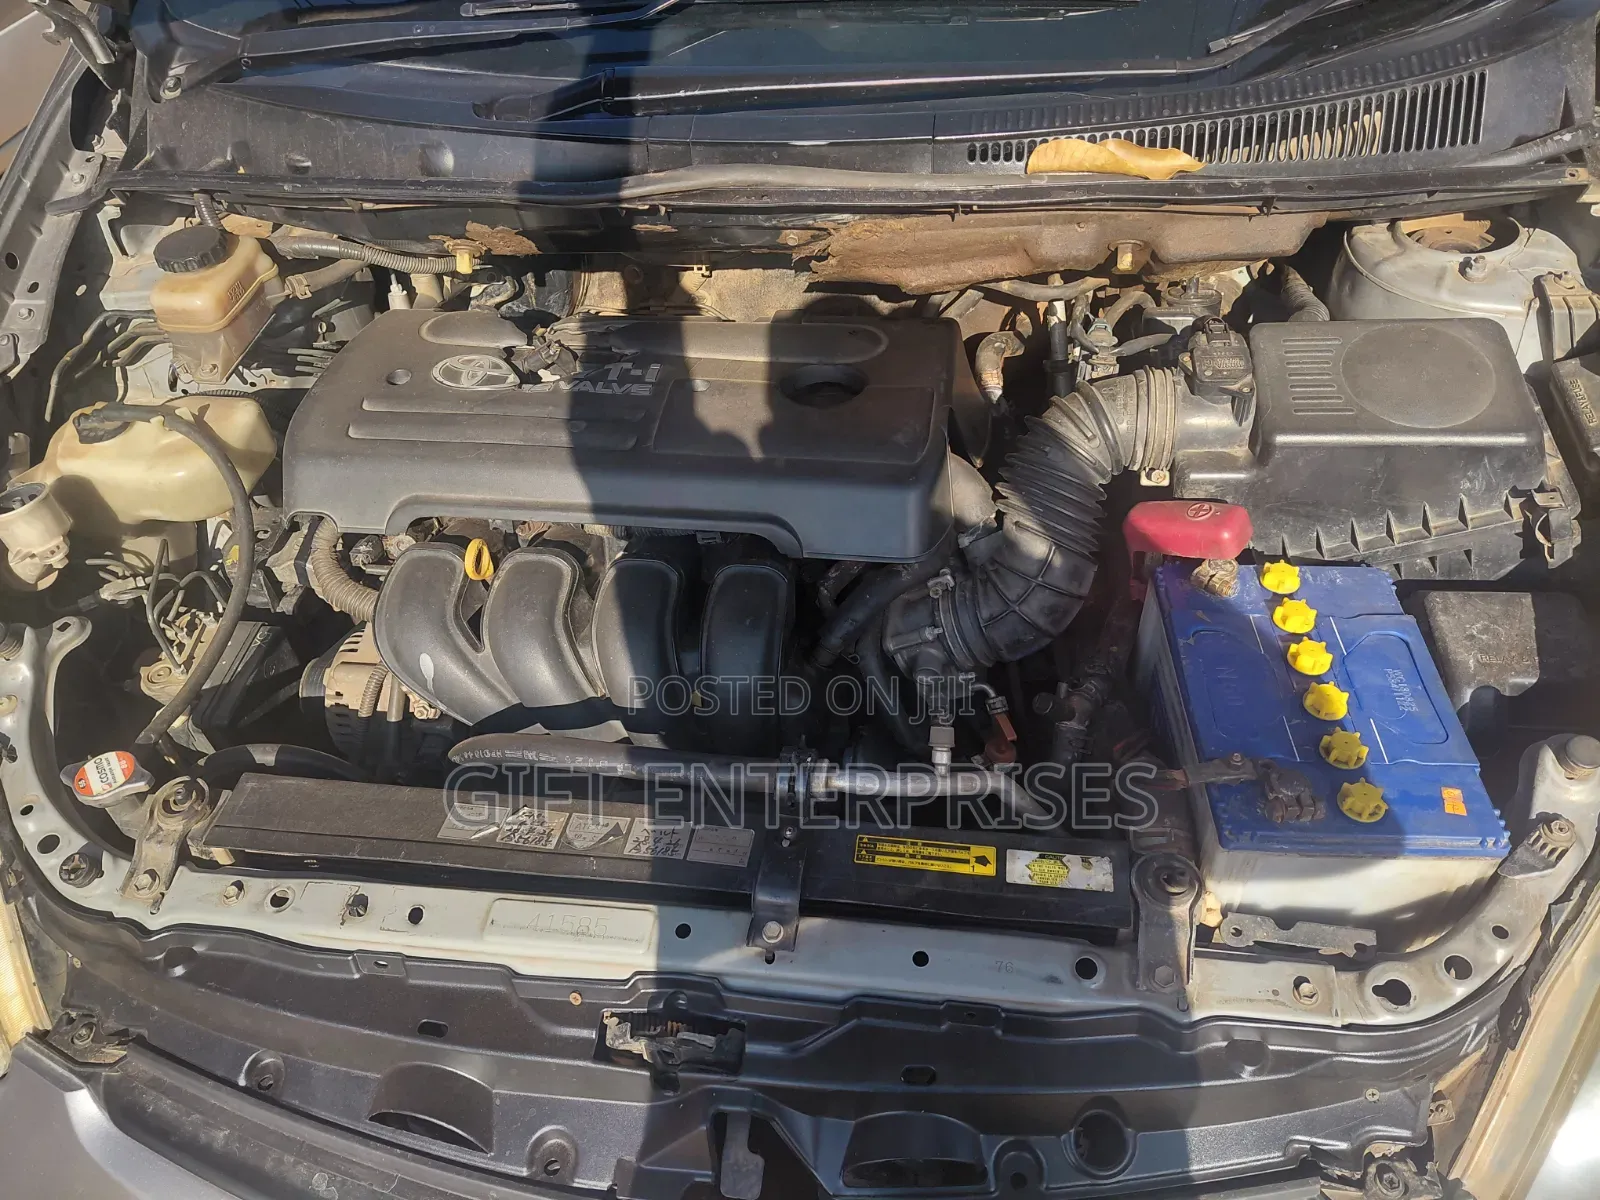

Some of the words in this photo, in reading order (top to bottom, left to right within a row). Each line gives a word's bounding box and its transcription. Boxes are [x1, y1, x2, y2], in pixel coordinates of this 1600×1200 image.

[558, 380, 653, 396] VALVE
[1479, 653, 1515, 665] RELAY
[94, 758, 109, 783] COSMO
[526, 912, 612, 937] 41585
[995, 960, 1014, 973] 76
